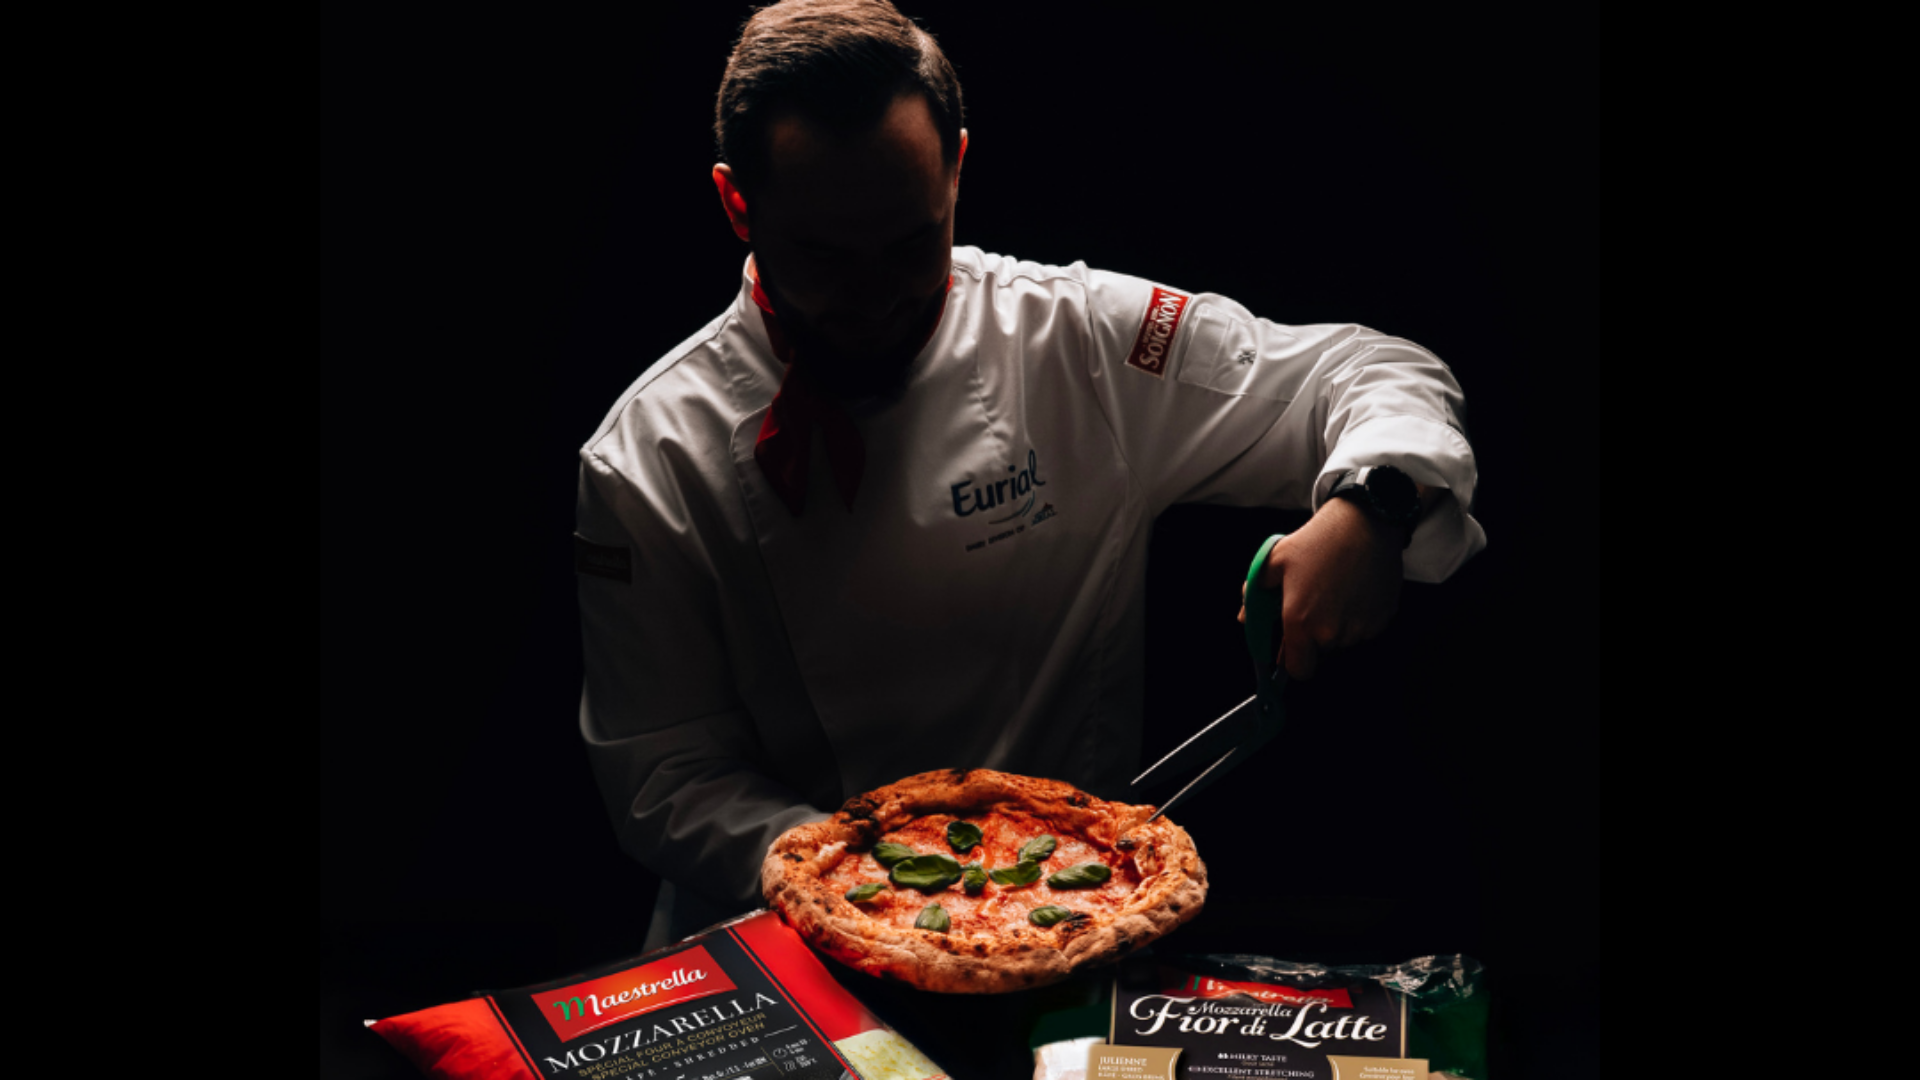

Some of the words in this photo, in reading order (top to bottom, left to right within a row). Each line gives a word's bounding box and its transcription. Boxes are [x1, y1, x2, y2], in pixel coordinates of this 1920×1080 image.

[951, 449, 1046, 517] Eurial
[553, 967, 707, 1021] Maestrella
[1187, 1001, 1293, 1017] Mozzarella
[543, 992, 779, 1074] MOZZARELLA
[652, 1033, 725, 1063] CONVEYOR
[728, 1021, 766, 1039] OVEN
[687, 1012, 767, 1043] CONVOYEUR
[1129, 994, 1239, 1036] Fior
[1240, 1018, 1268, 1036] di
[1269, 1001, 1388, 1049] Latte
[1100, 1056, 1148, 1067] JULIENNE
[1203, 1066, 1252, 1076] EXCELLENT
